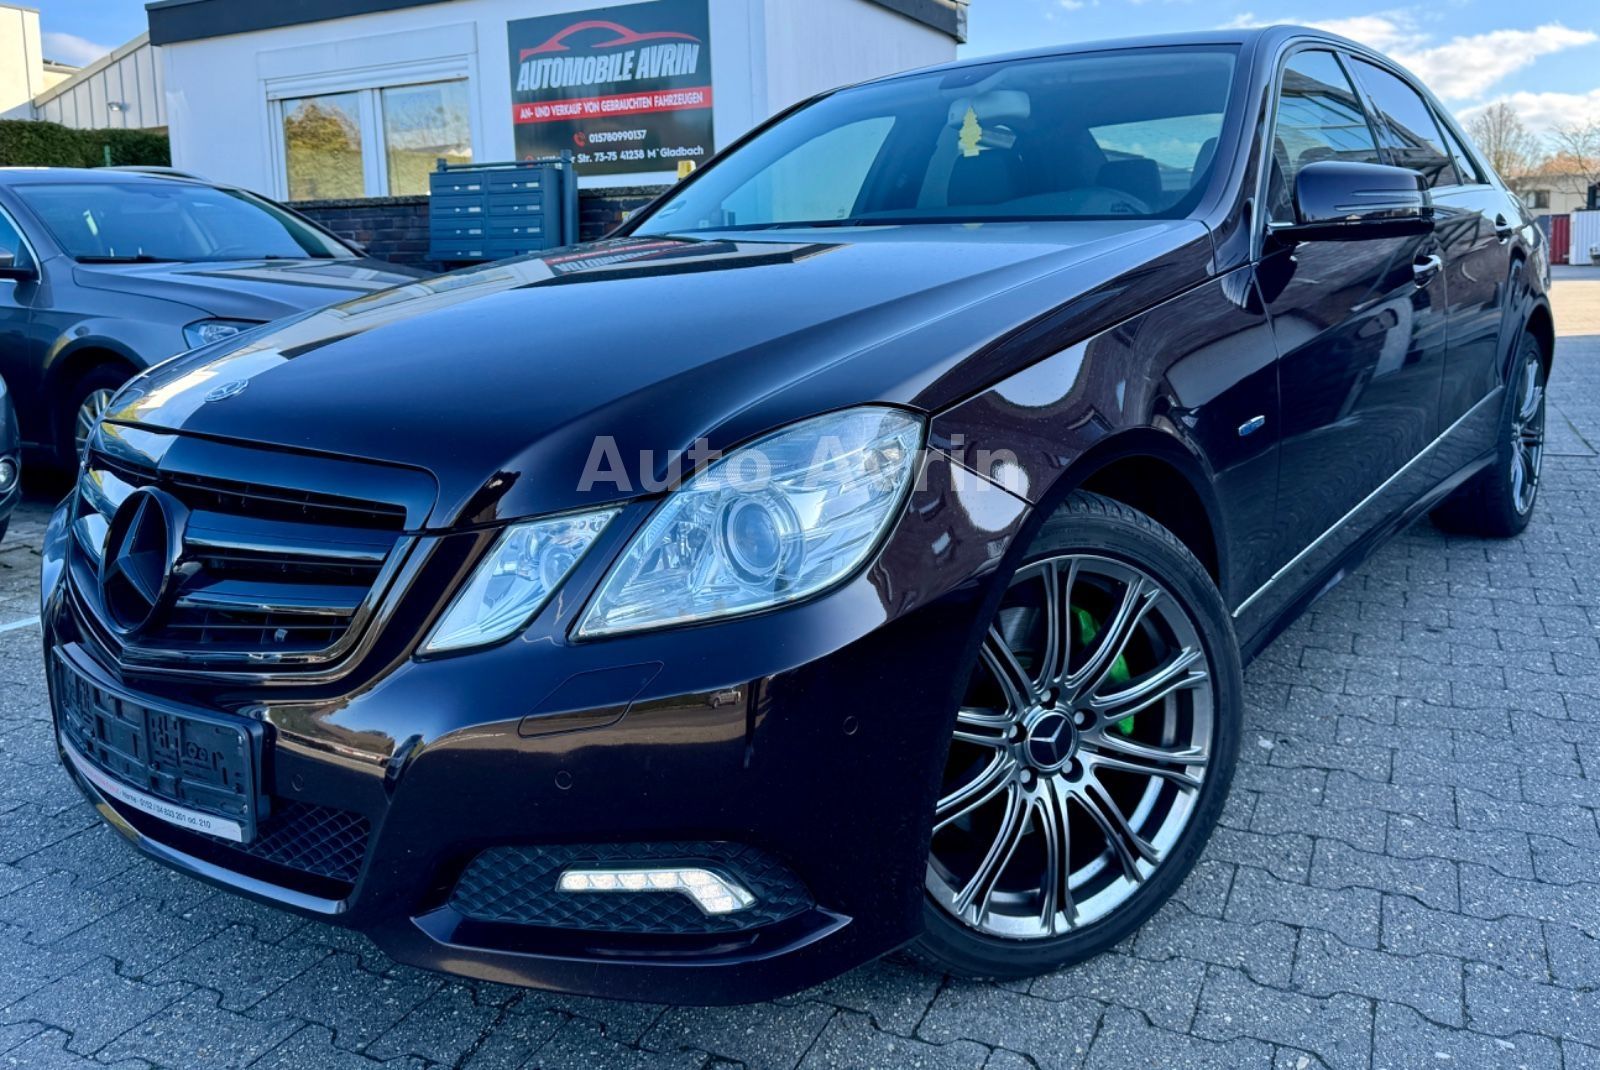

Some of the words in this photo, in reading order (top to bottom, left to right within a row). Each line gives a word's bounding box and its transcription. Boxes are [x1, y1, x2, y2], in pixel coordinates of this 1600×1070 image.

[516, 50, 635, 92] AUTOMOBILE
[635, 43, 700, 80] AVRIN
[534, 105, 550, 118] UND
[551, 103, 582, 116] VERKAUF
[583, 101, 600, 114] VON
[600, 96, 653, 112] GEBRAUCHTEN
[654, 91, 704, 107] FAHRZEUGEN
